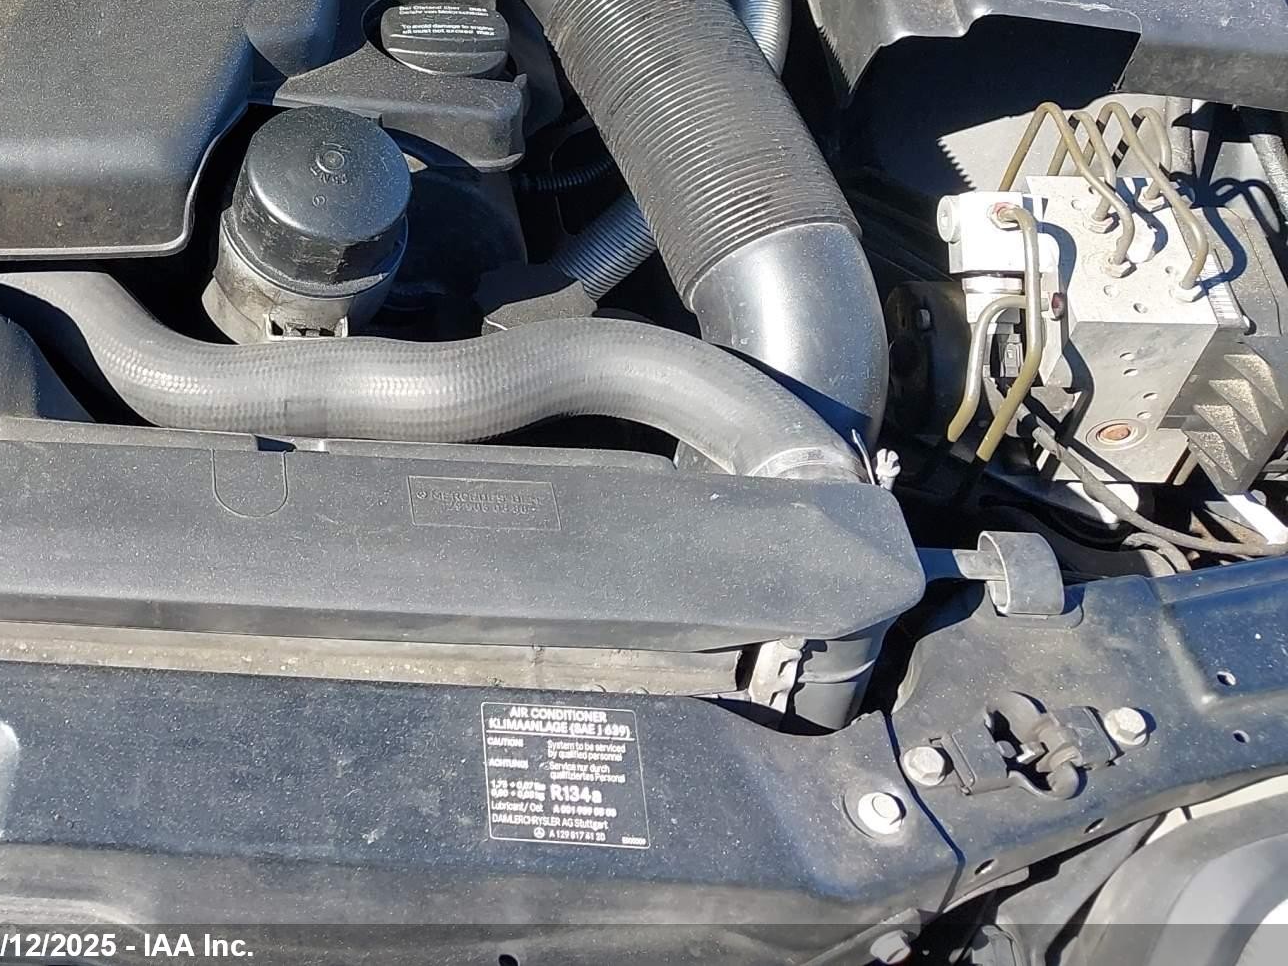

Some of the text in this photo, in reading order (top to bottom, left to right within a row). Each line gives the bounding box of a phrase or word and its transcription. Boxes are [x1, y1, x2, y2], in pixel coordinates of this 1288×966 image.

[510, 706, 607, 723] AIR CONDITIONER
[488, 717, 568, 734] KLIMAANLAGE
[569, 722, 596, 736] (SAE
[604, 724, 631, 738] 639)
[547, 740, 626, 753] System to be serviced
[547, 749, 622, 762] by qualified personnel
[549, 761, 610, 773] Service nur durch
[594, 772, 626, 783] Personal
[550, 783, 602, 804] R134a
[552, 806, 560, 815] A
[491, 813, 609, 831] DAIMLERCHRYSLER AG Stuttgart
[548, 831, 556, 839] A
